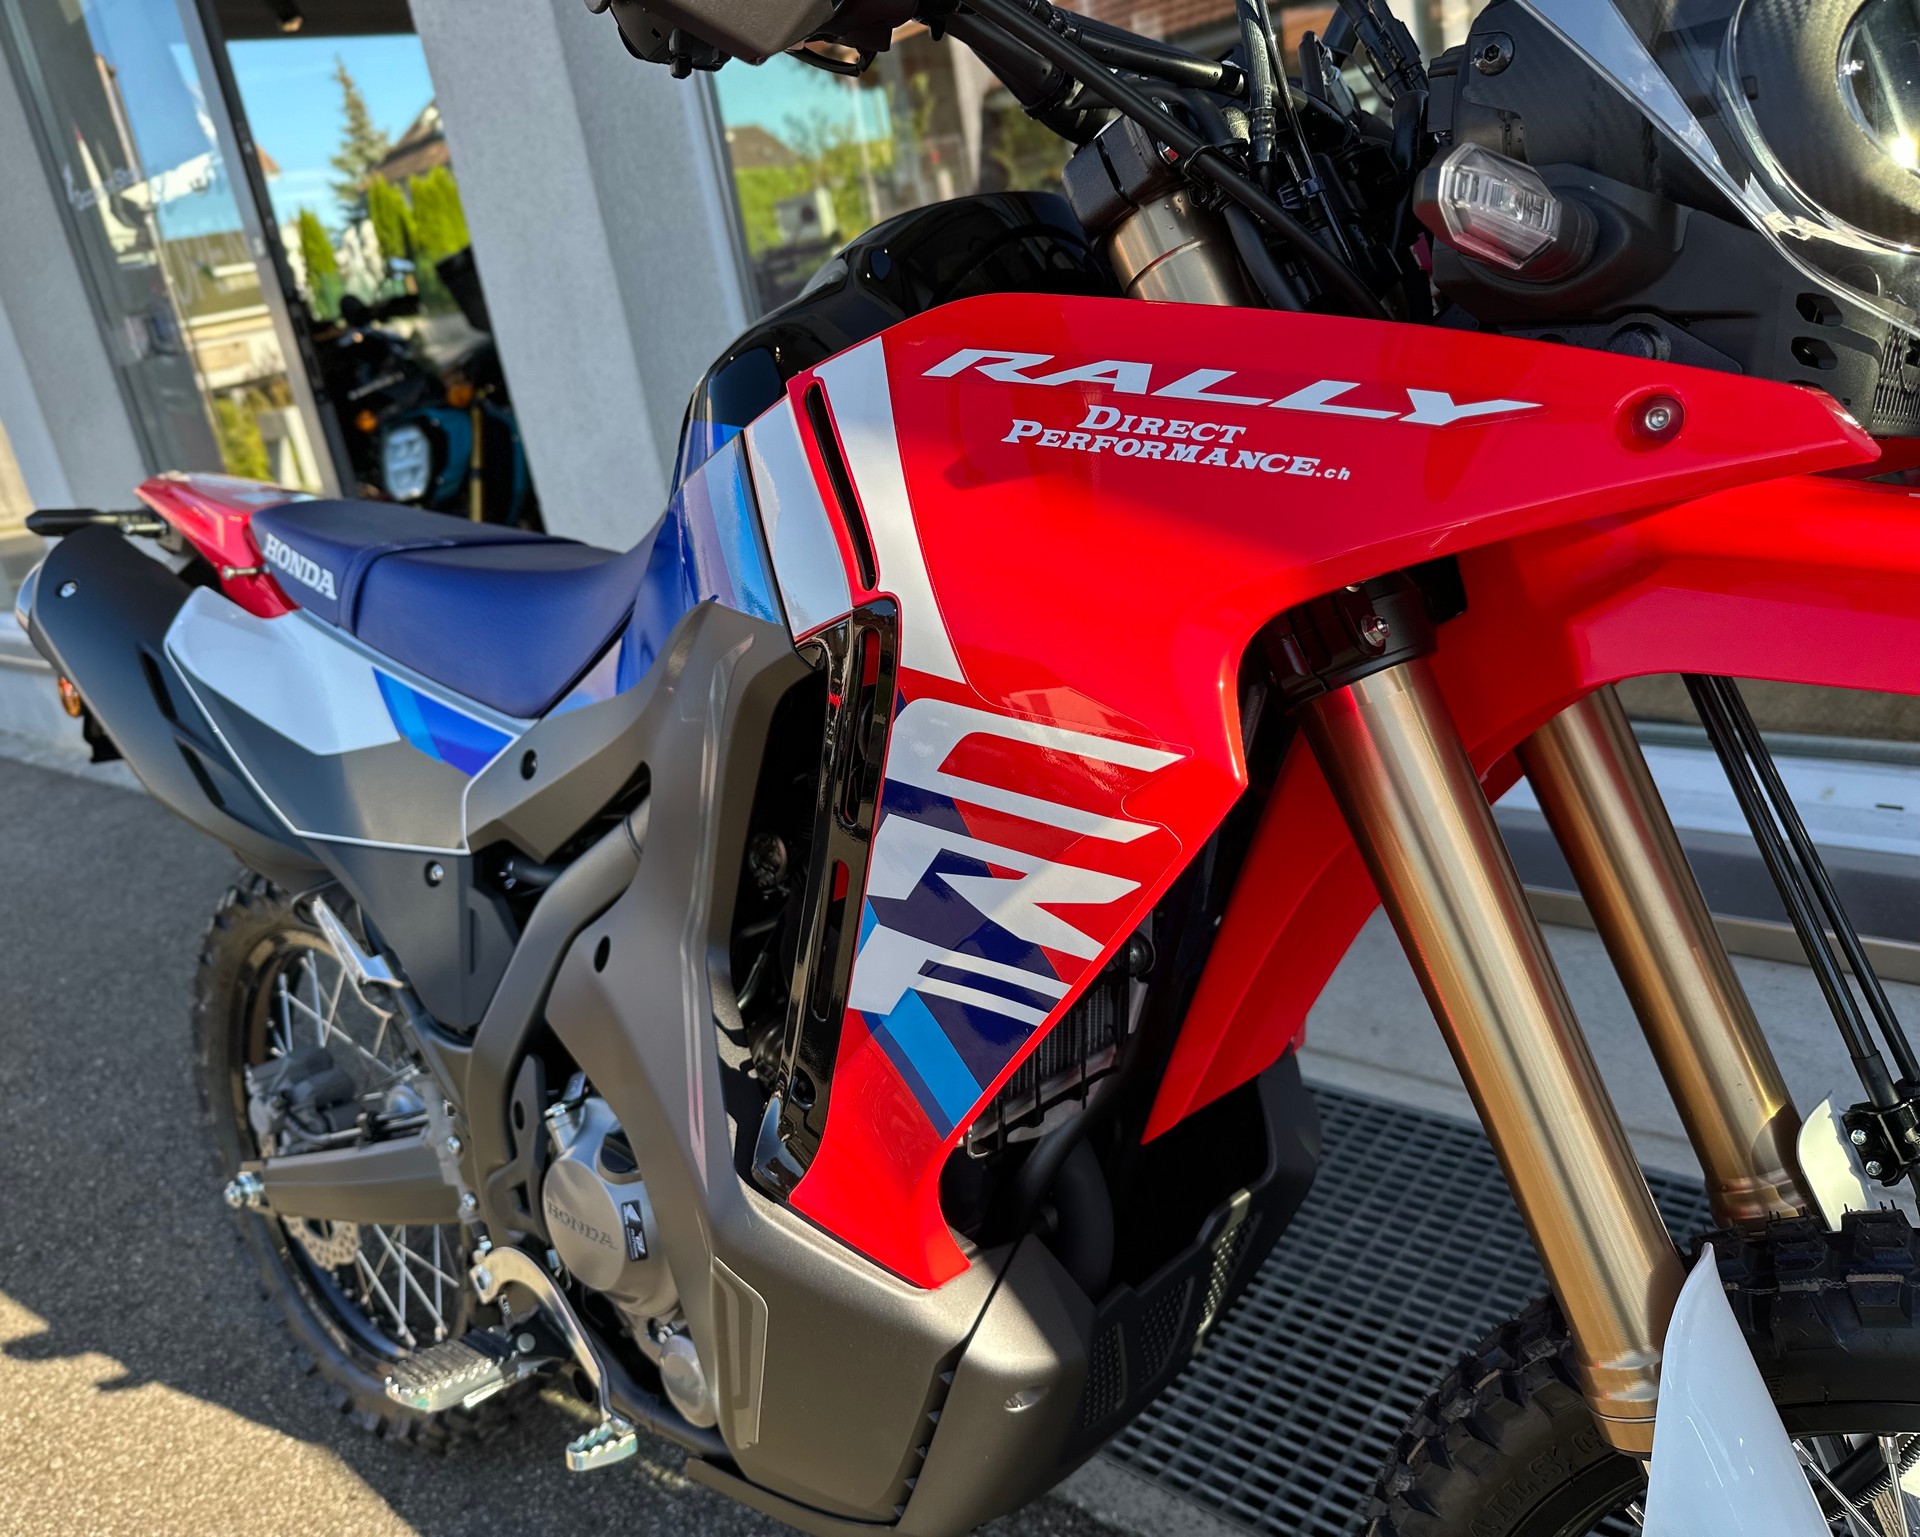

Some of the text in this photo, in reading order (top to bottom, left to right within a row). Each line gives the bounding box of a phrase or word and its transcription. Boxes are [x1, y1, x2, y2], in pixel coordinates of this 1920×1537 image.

[921, 348, 1544, 426] RALLY
[1001, 419, 1352, 481] PERFORMANCE.ch
[1083, 404, 1246, 445] DIRECT
[262, 532, 338, 601] HONDA
[546, 1199, 618, 1251] HONDA
